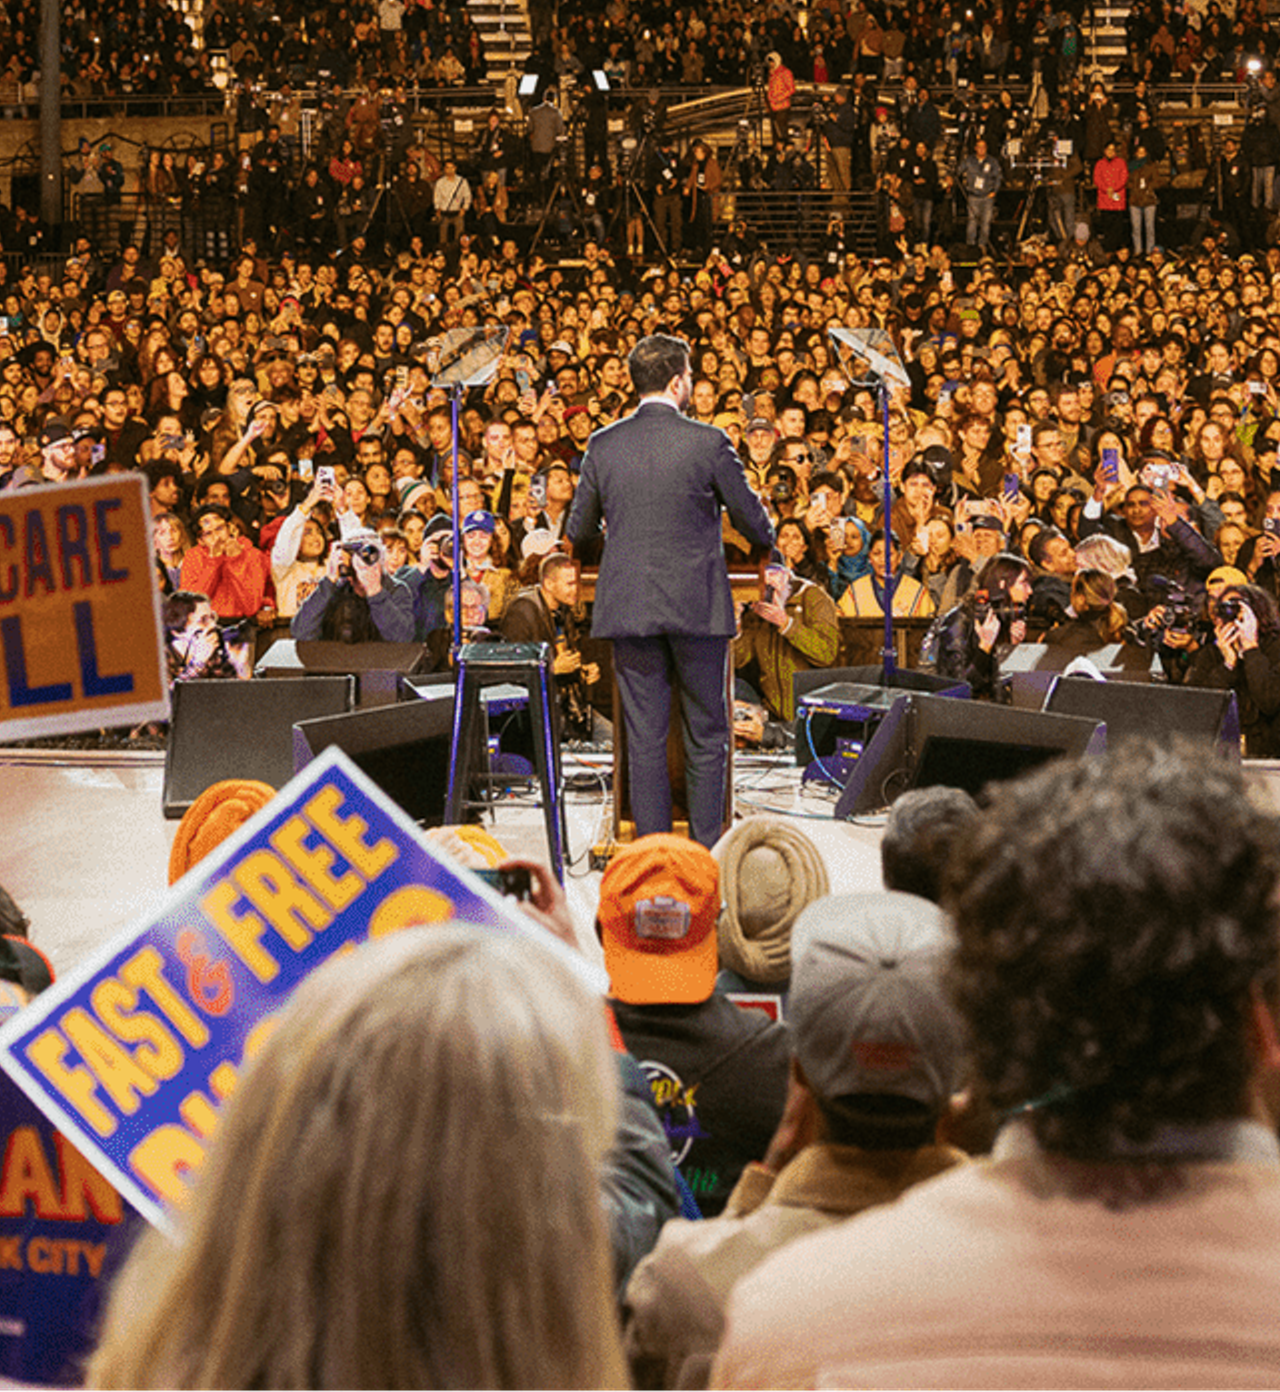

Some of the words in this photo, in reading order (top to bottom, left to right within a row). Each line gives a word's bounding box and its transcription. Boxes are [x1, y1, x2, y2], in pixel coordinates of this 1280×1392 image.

[25, 946, 211, 1139] FAST
[200, 783, 400, 984] FREE
[26, 1236, 107, 1278] CITY
